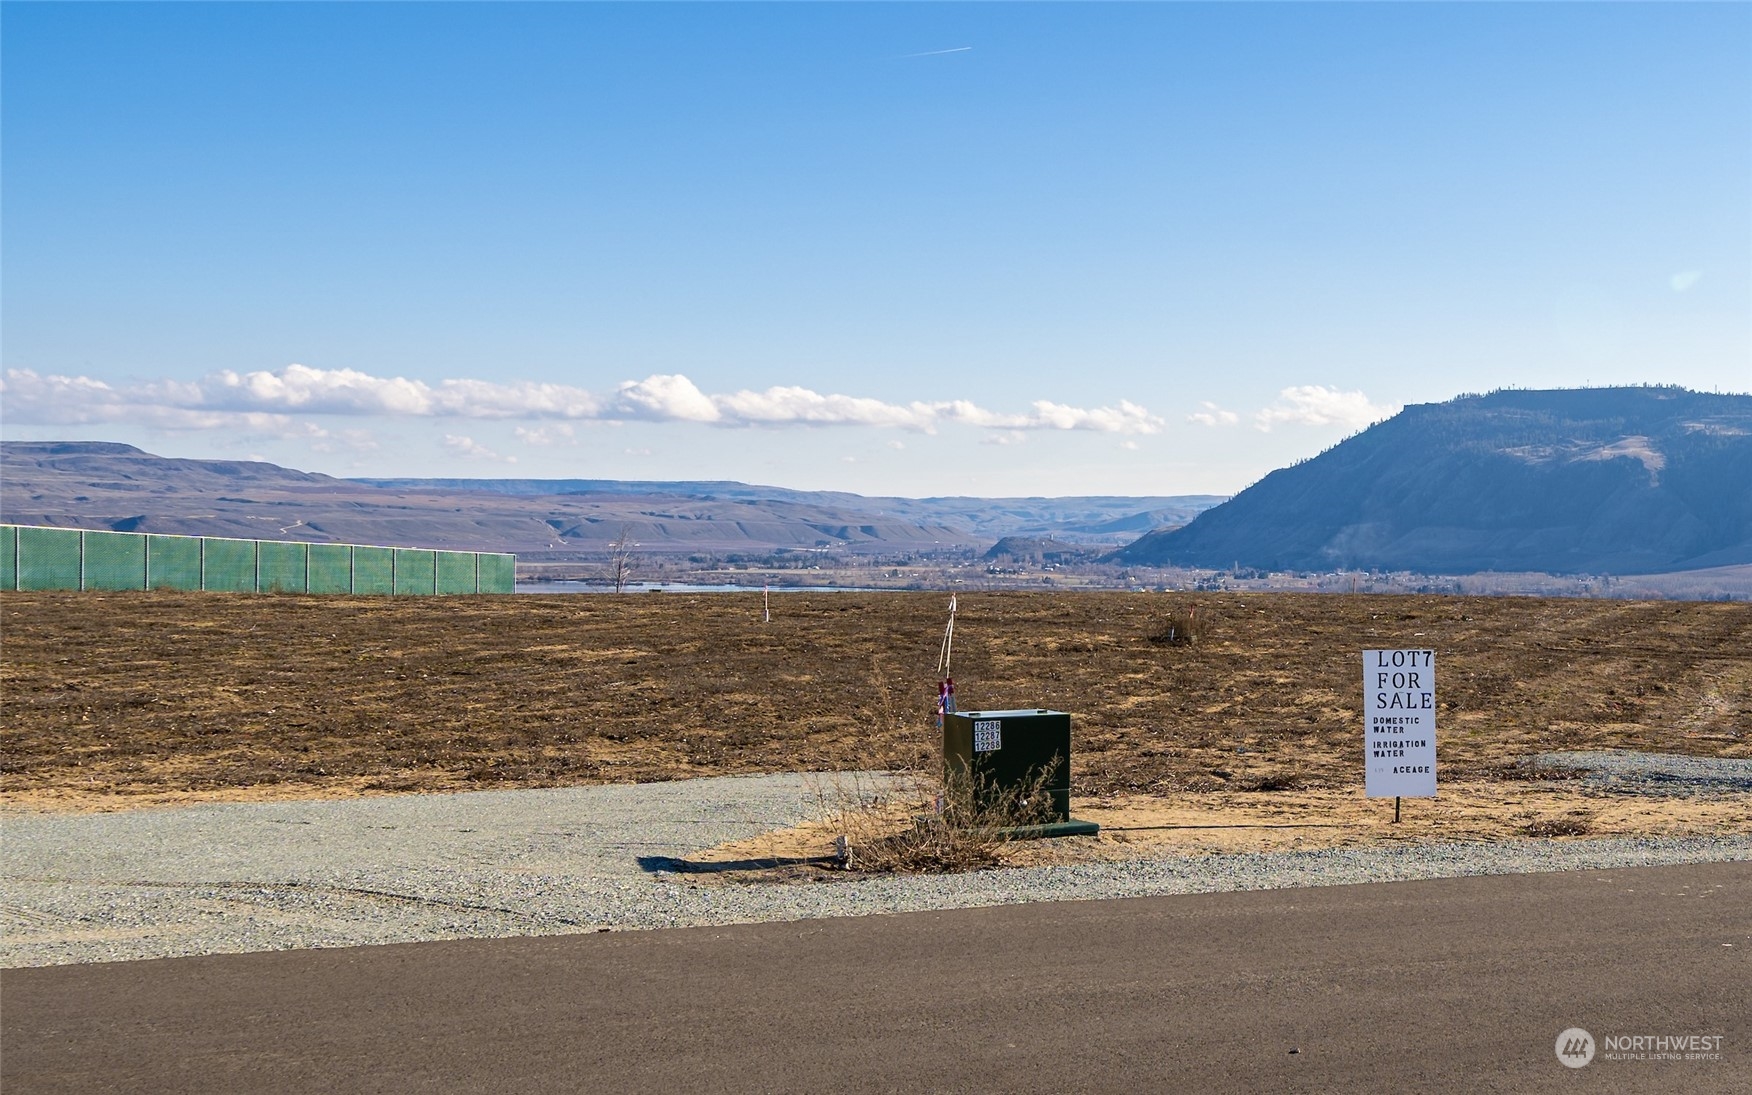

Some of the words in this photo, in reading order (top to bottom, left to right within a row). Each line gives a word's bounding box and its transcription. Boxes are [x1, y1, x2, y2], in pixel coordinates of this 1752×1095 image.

[1377, 672, 1421, 688] FOR
[1377, 692, 1432, 709] SALE
[975, 721, 1000, 730] 12286
[1373, 717, 1420, 725] DOMESTIC
[1373, 726, 1405, 734] WATER
[975, 731, 1000, 741] 12287
[975, 741, 1000, 750] 12288
[1373, 740, 1426, 749] IRRIGATION
[1373, 750, 1405, 758] WATER
[1393, 766, 1430, 774] ACEAGE
